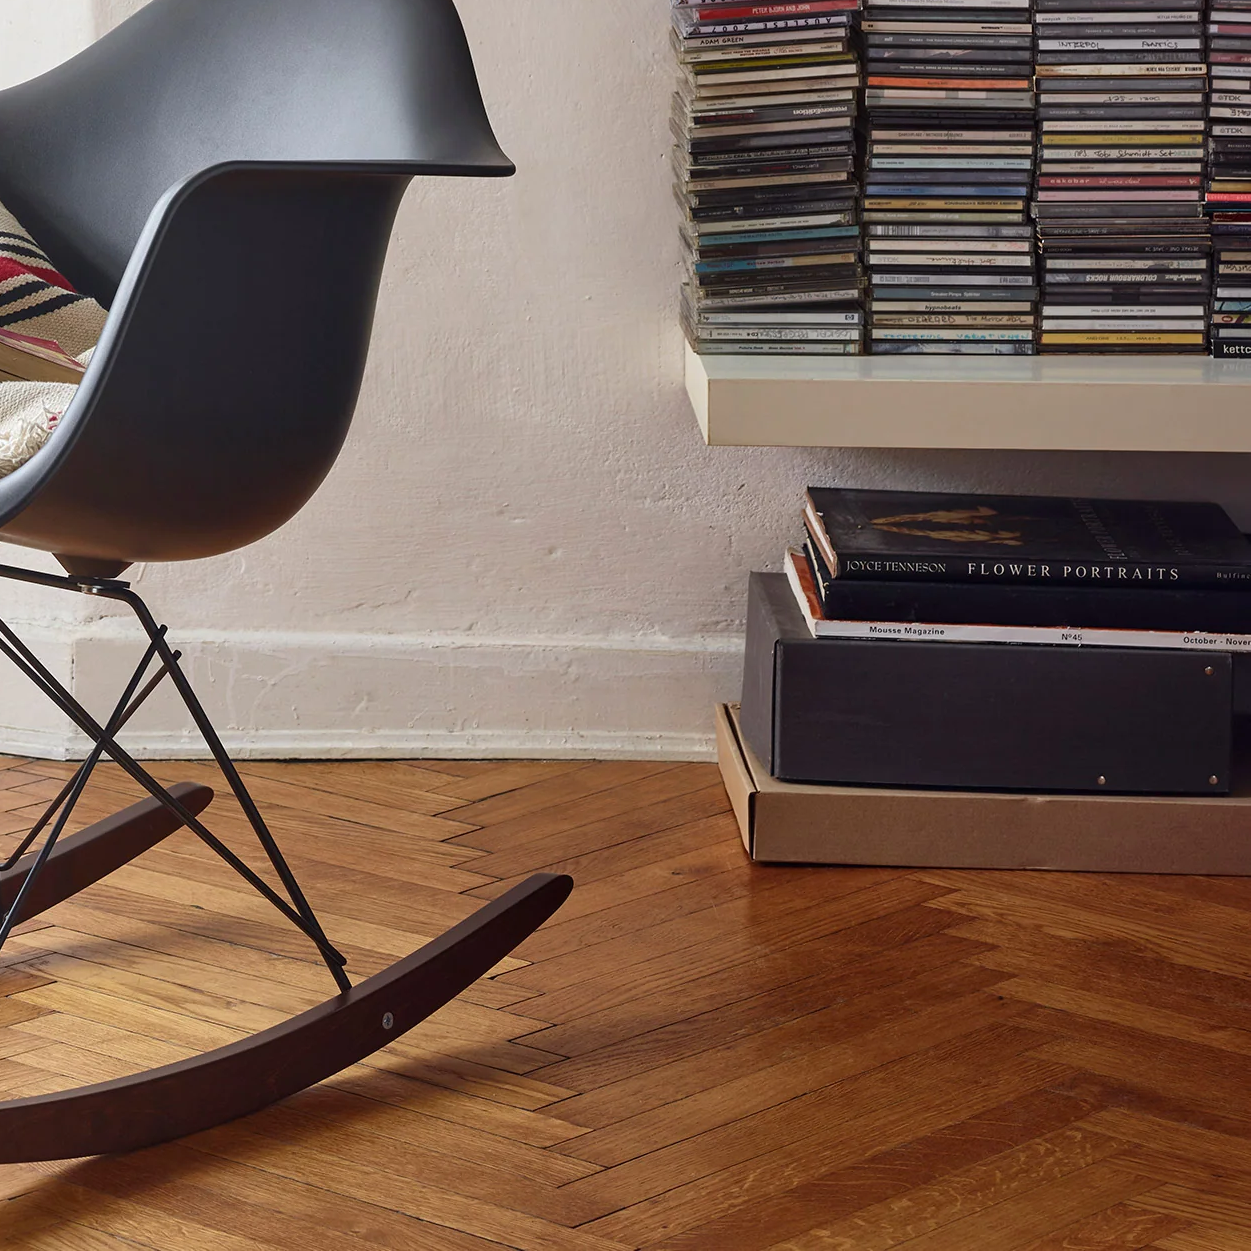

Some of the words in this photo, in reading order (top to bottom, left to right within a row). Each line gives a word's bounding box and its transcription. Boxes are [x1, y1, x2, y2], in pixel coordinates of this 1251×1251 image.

[752, 6, 768, 15] PETER
[796, 4, 810, 12] JOHN
[764, 17, 832, 29] AUSLESE
[711, 24, 749, 34] 2007
[700, 37, 720, 46] ADAM
[722, 36, 744, 44] GREEN
[1058, 40, 1105, 50] INTERPOL
[1142, 40, 1178, 49] ANTICS
[1116, 149, 1152, 158] Schmidt
[925, 304, 961, 312] hypnobeats
[846, 560, 882, 572] JOYCE
[884, 561, 946, 573] TENNESON
[968, 563, 1051, 577] FLOWER
[1063, 566, 1179, 580] PORTRAITS
[869, 626, 902, 634] Mousse
[904, 627, 945, 637] Magazine
[1183, 636, 1217, 645] October
